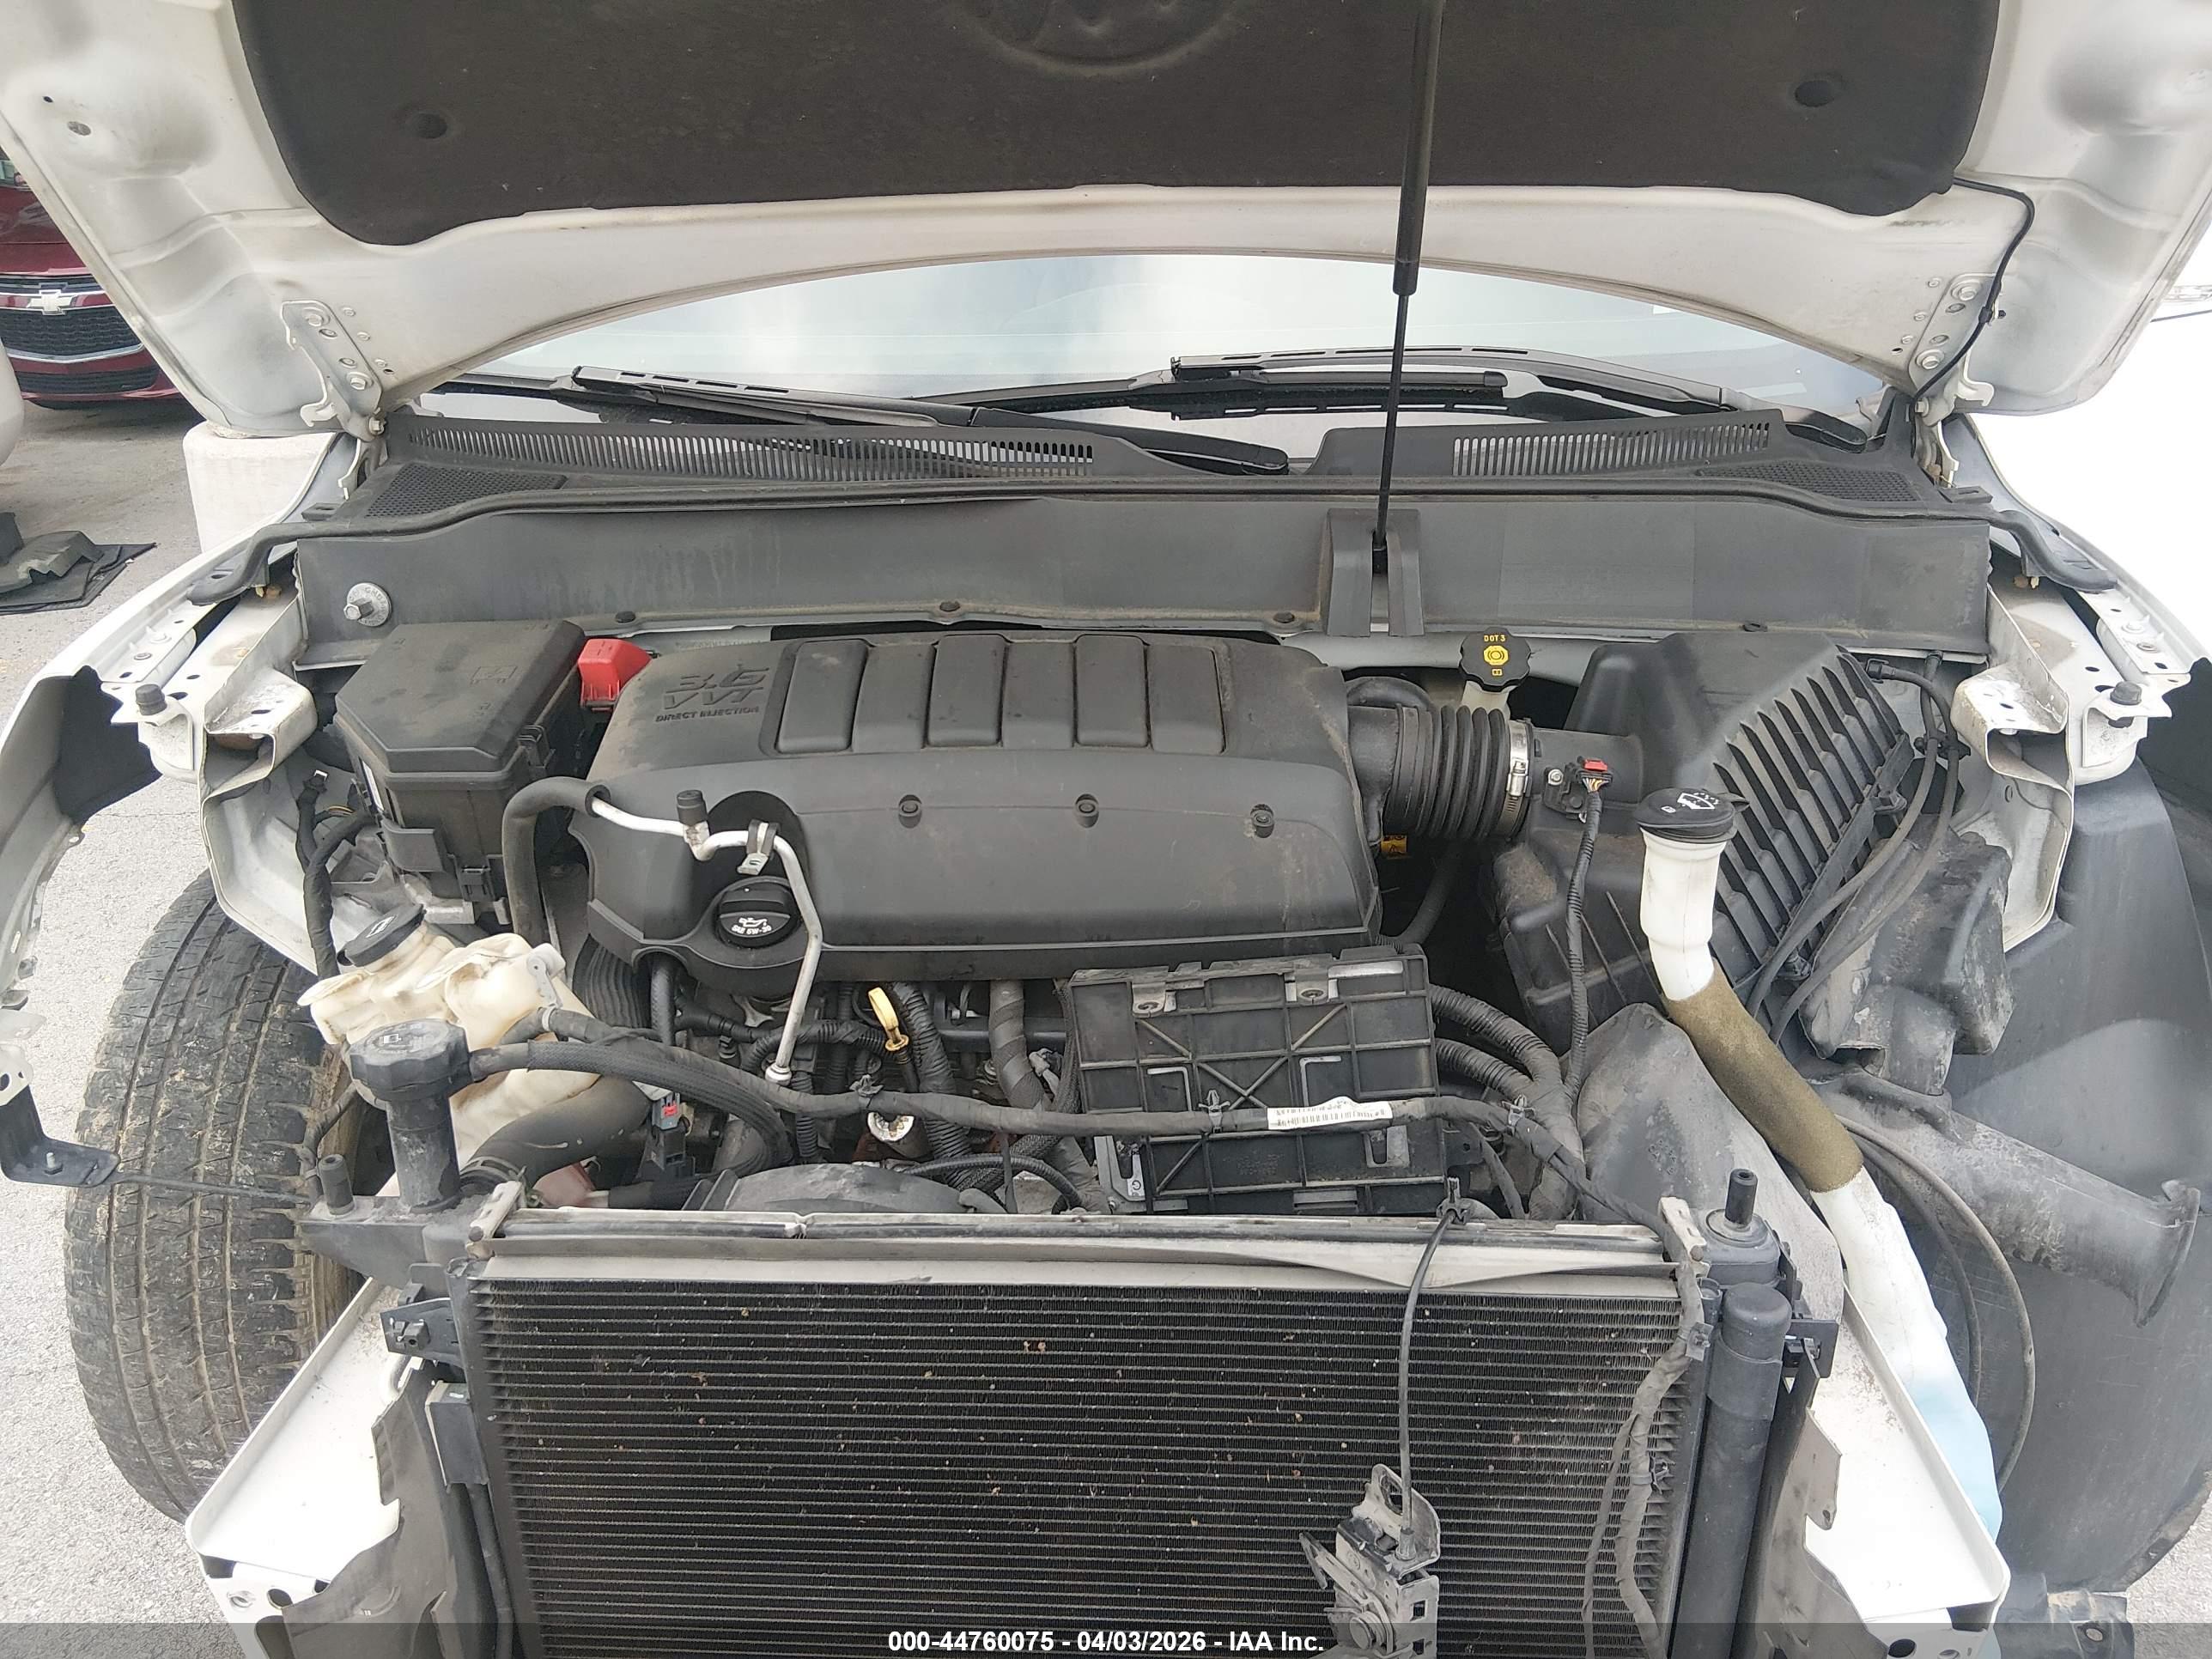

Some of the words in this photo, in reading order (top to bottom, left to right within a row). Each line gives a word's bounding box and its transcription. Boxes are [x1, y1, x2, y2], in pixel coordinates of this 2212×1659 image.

[663, 687, 764, 710] VVT
[655, 710, 698, 722] DIRECT
[700, 706, 759, 718] INJECTION
